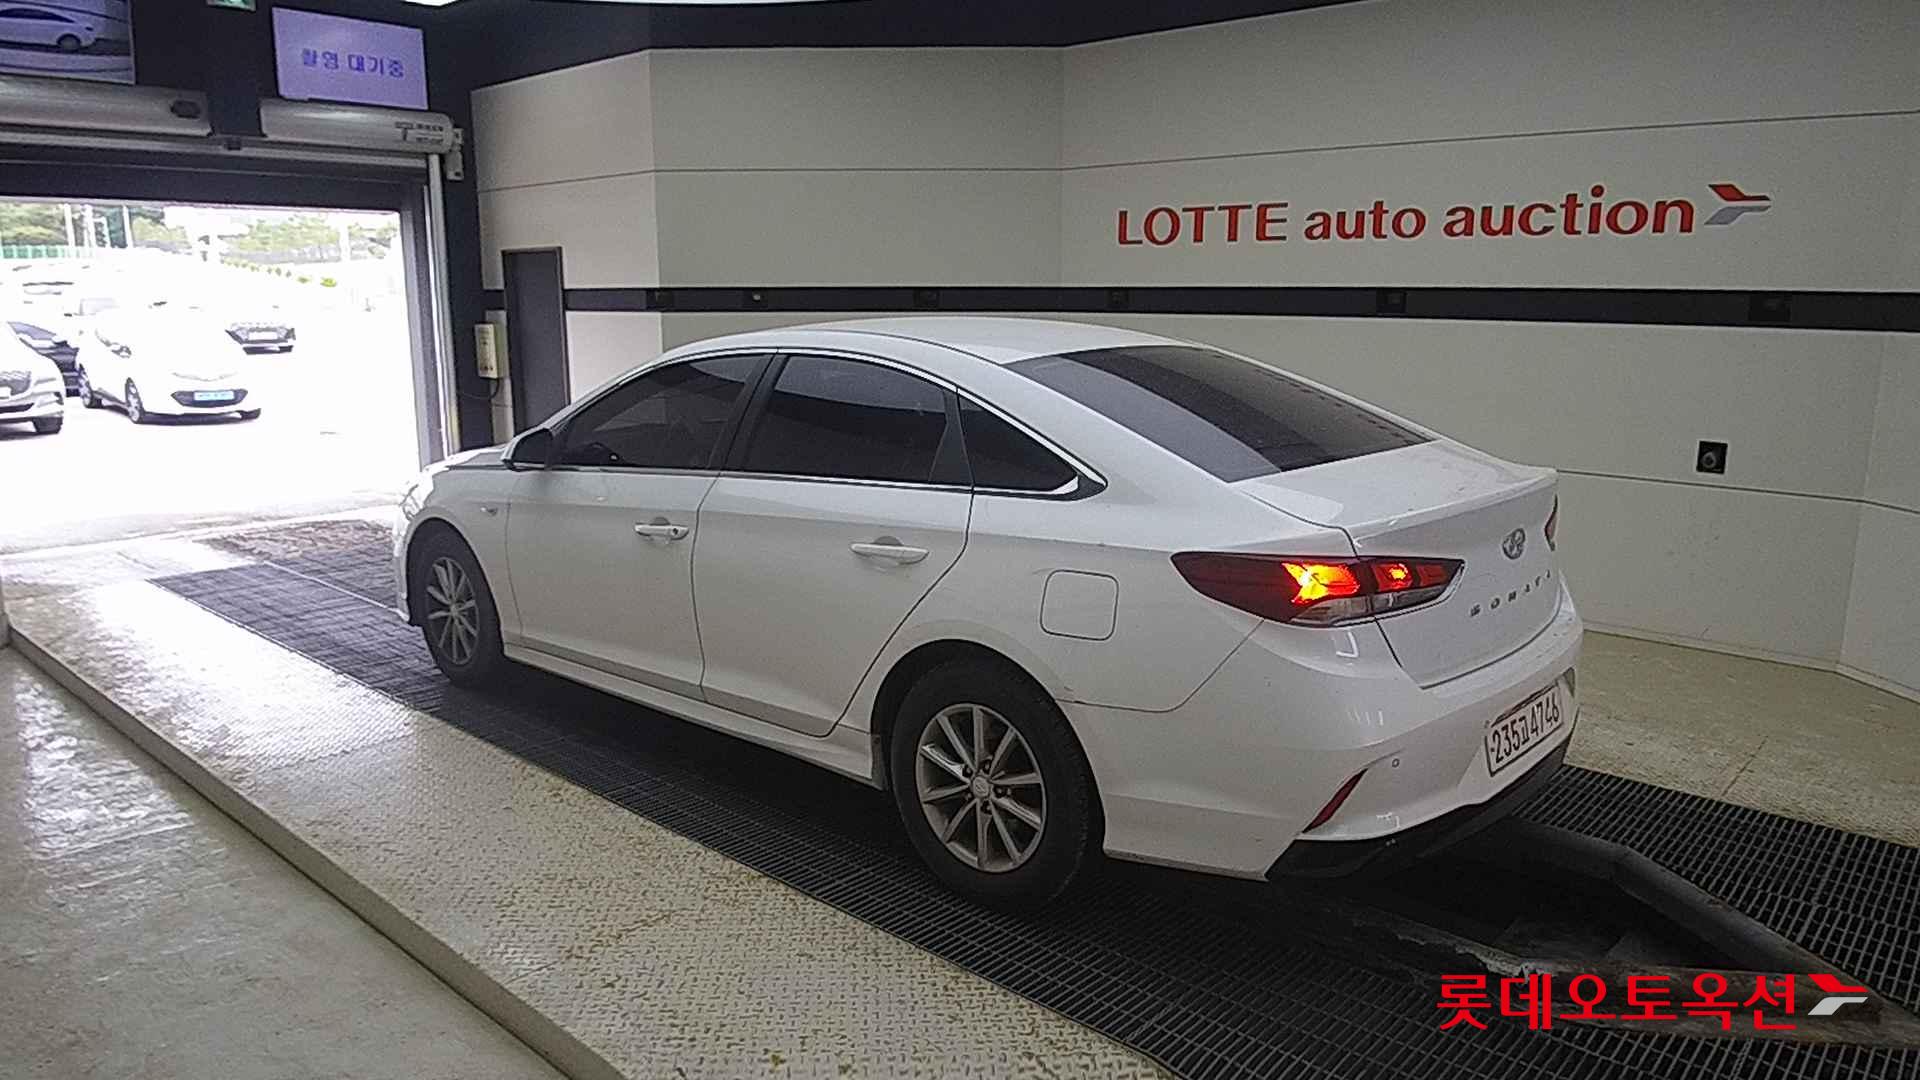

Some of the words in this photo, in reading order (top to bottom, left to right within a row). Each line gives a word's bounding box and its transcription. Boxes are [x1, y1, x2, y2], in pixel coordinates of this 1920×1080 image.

[1118, 202, 1288, 246] LOTTE
[1303, 200, 1426, 242] auto
[1442, 184, 1695, 238] auction
